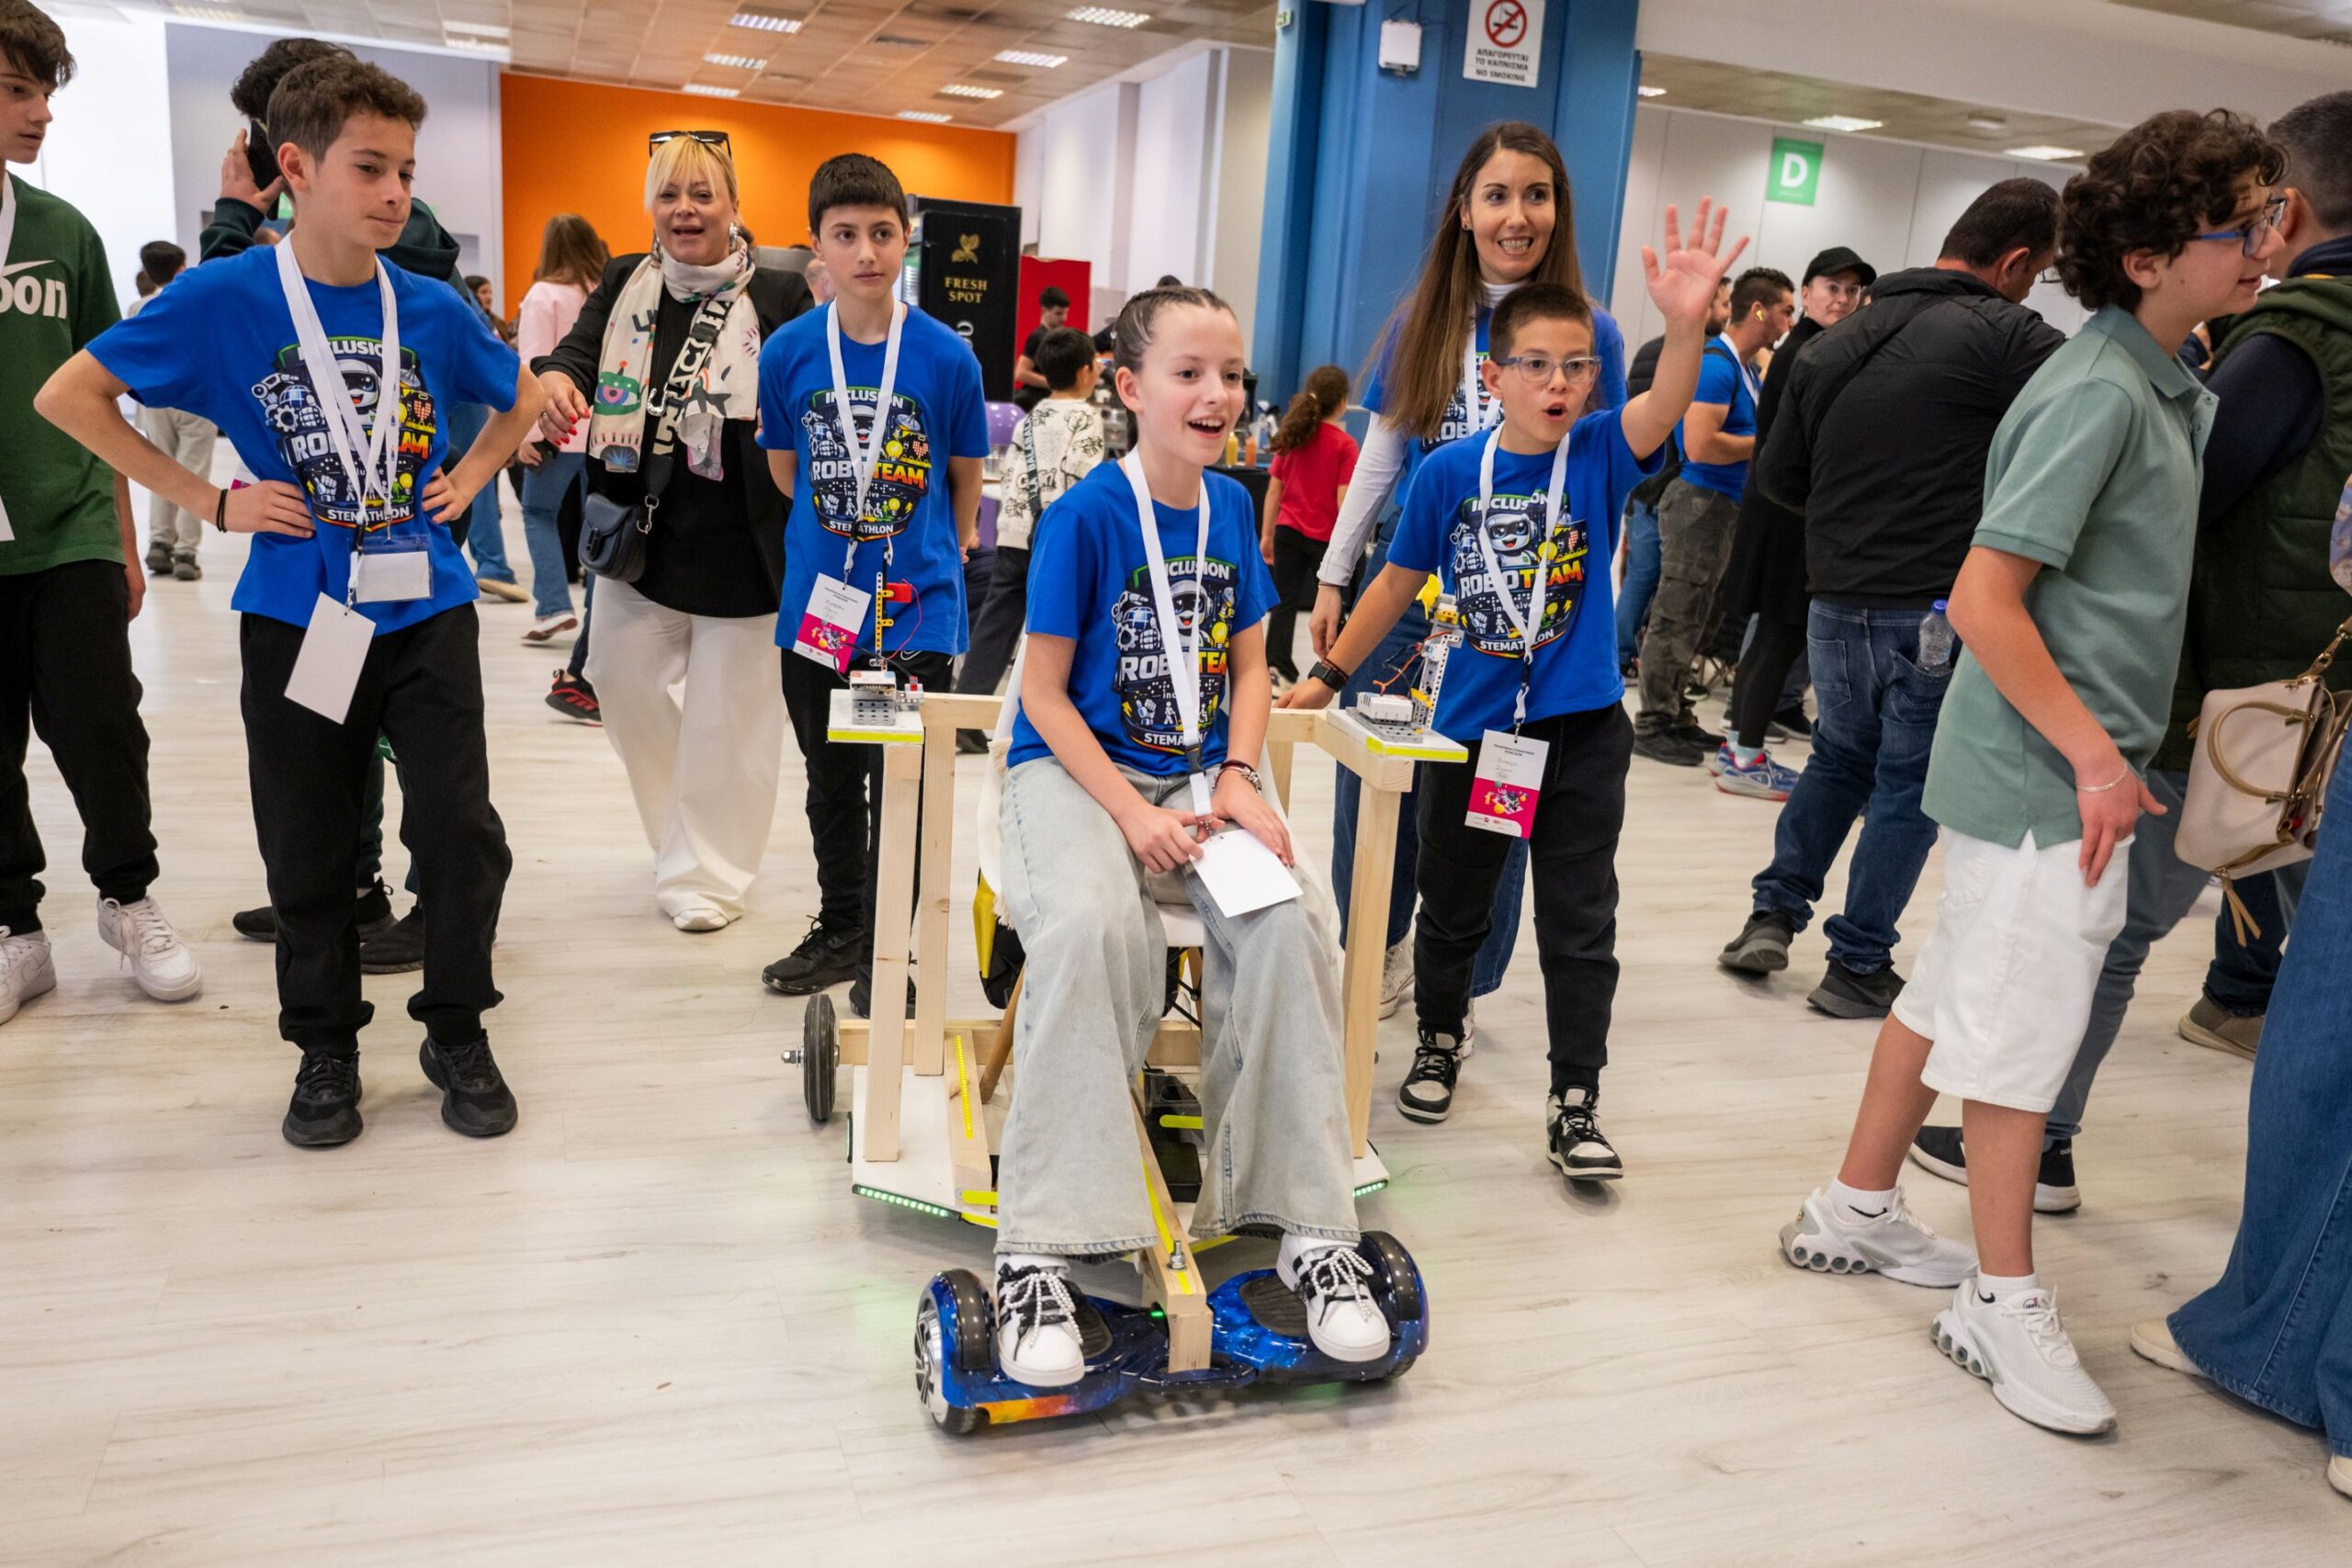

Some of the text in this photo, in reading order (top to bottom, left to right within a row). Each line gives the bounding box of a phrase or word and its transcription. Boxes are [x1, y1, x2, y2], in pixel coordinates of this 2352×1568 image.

[1476, 68, 1525, 82] NO SMOKING
[1781, 152, 1808, 187] D
[944, 276, 988, 291] FRESH
[948, 290, 983, 304] SPOT
[812, 460, 924, 490] ROBTEAM
